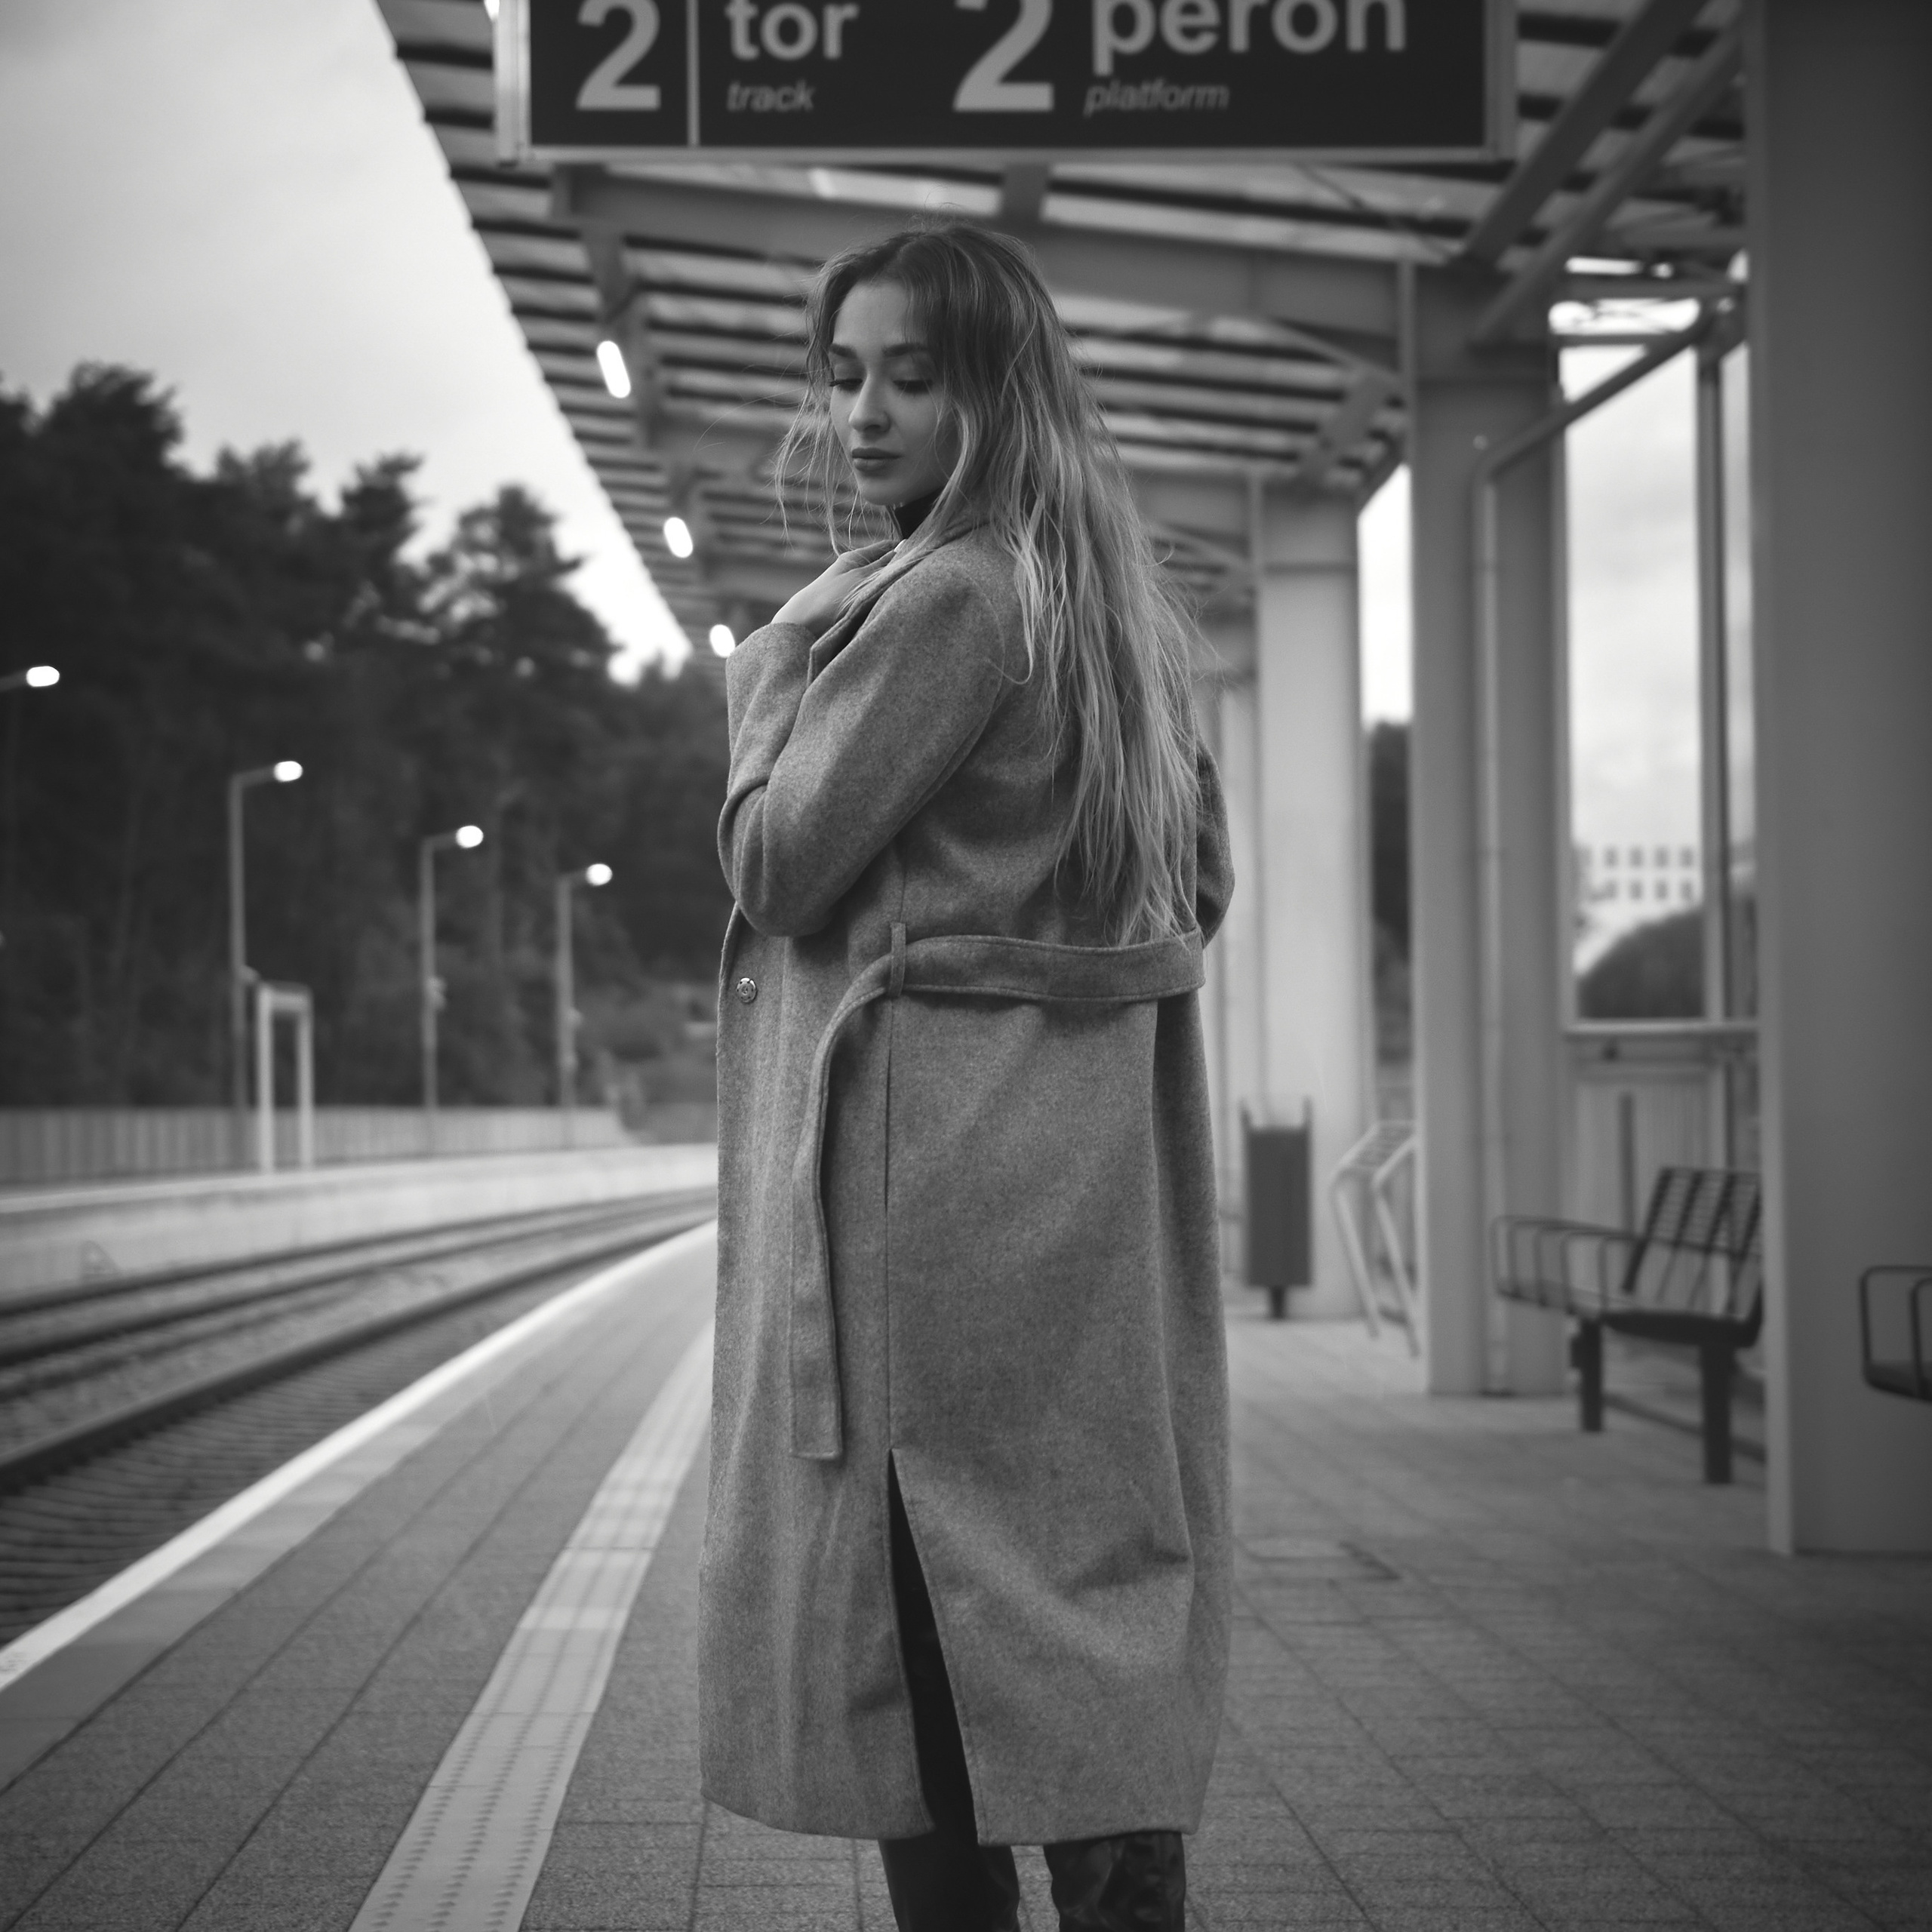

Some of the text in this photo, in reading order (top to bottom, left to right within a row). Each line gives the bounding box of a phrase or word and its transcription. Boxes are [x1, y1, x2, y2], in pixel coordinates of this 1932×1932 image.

[576, 0, 1406, 112] 2 tor 2 peron
[726, 79, 815, 112] track
[1083, 78, 1229, 115] platform
